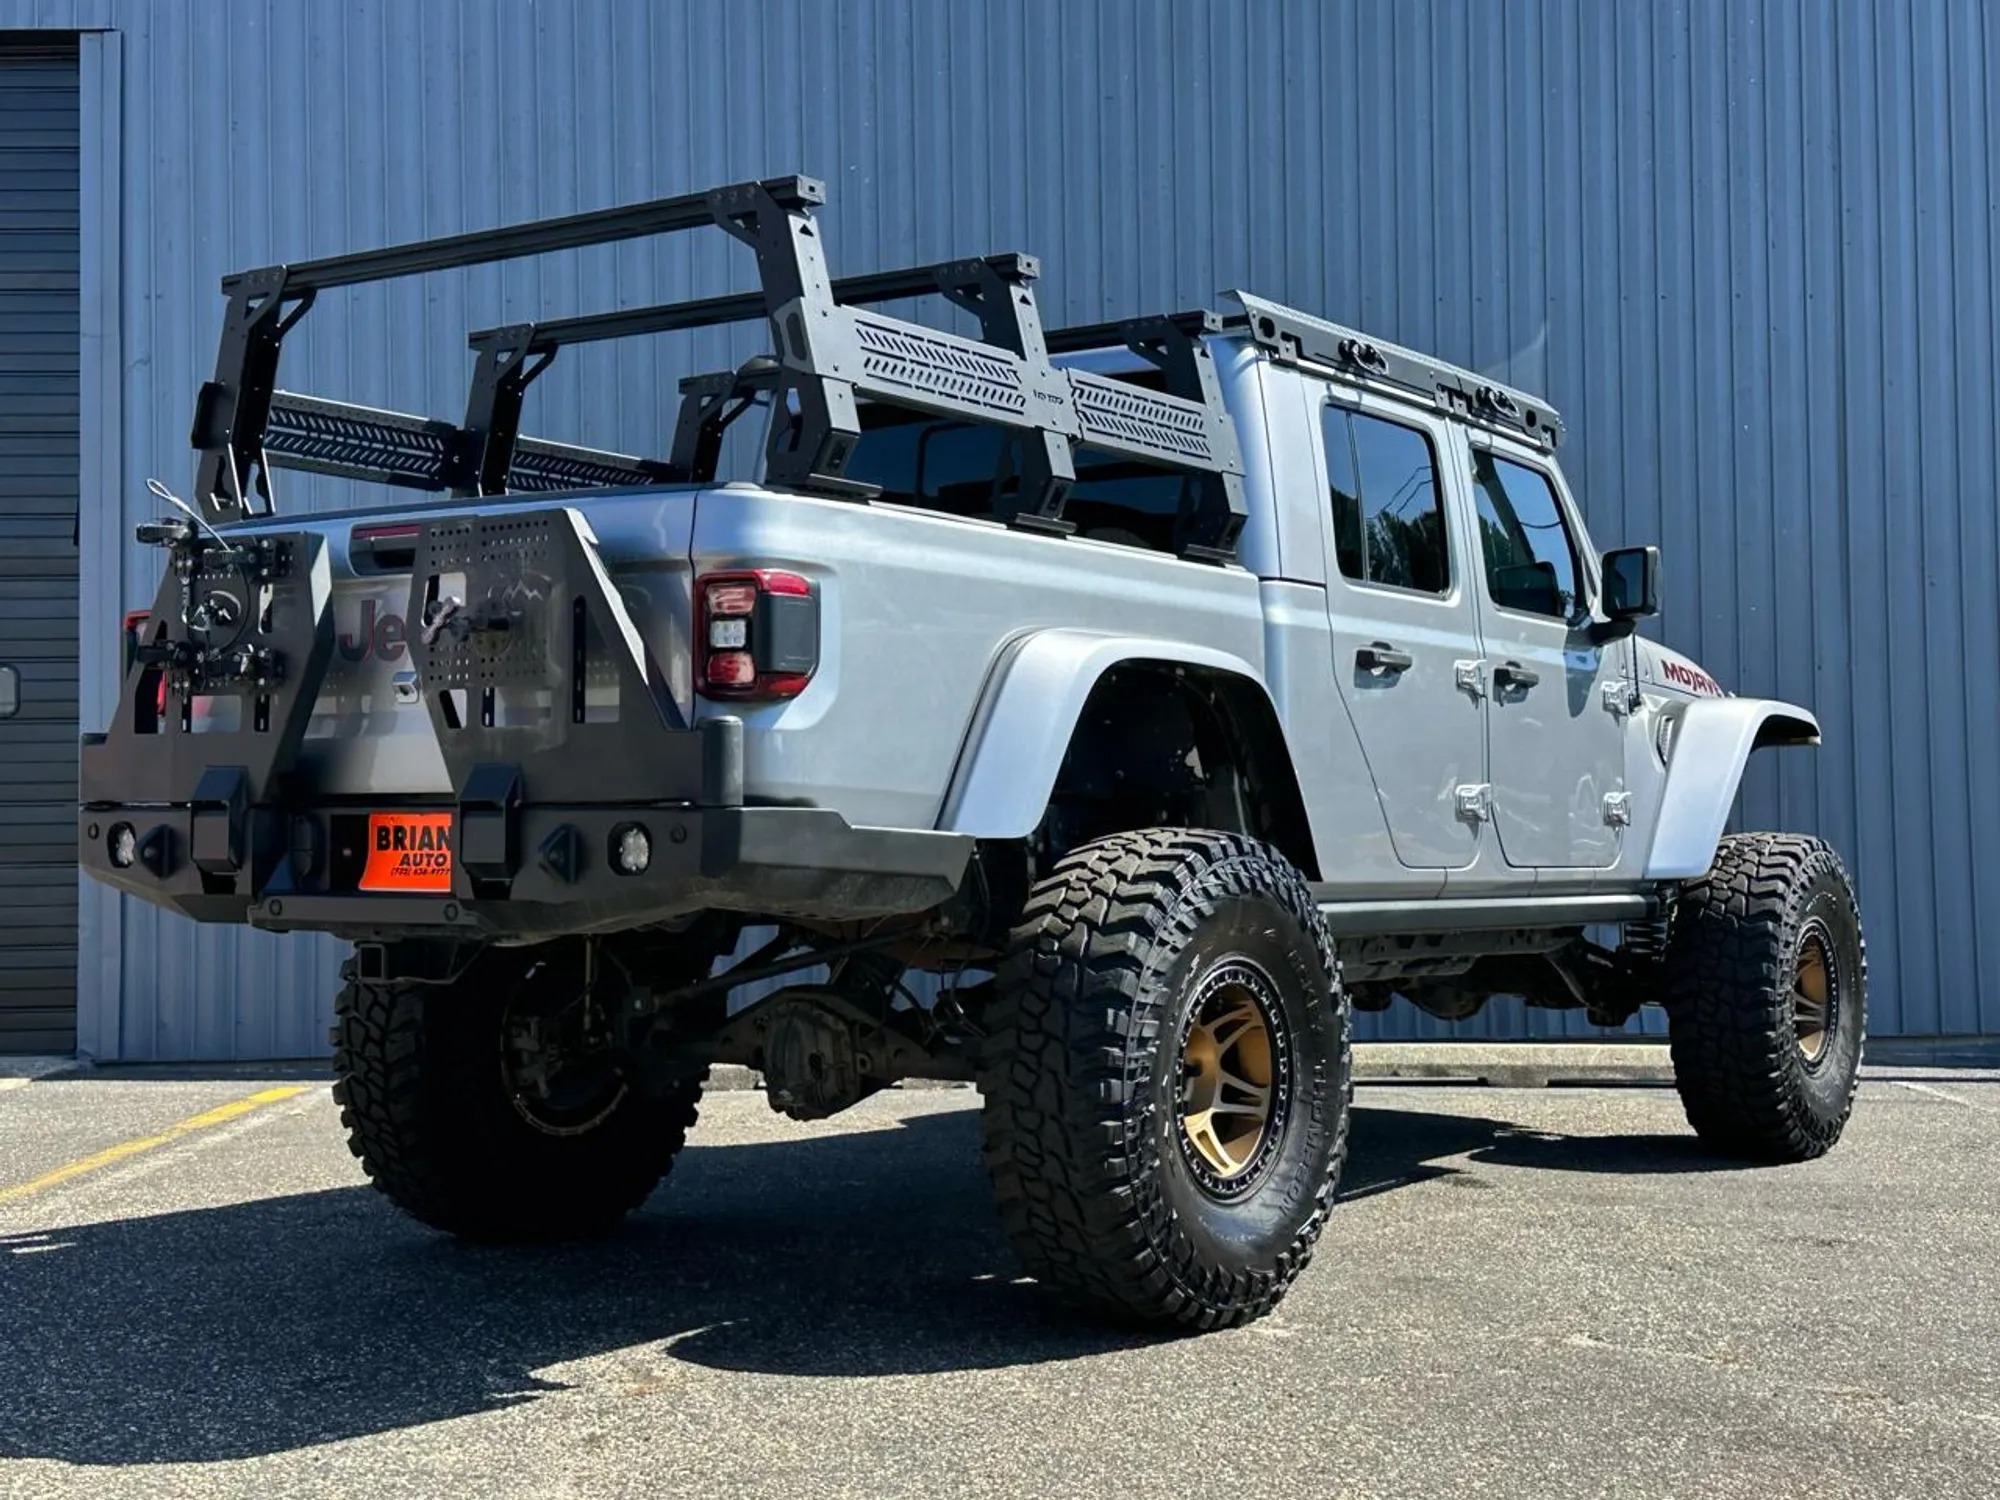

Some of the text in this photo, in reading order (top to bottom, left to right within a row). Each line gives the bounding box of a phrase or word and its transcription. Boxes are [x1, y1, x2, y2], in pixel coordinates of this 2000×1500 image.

[339, 600, 407, 661] Je
[376, 825, 451, 851] BRIAN
[398, 853, 447, 867] AUTO
